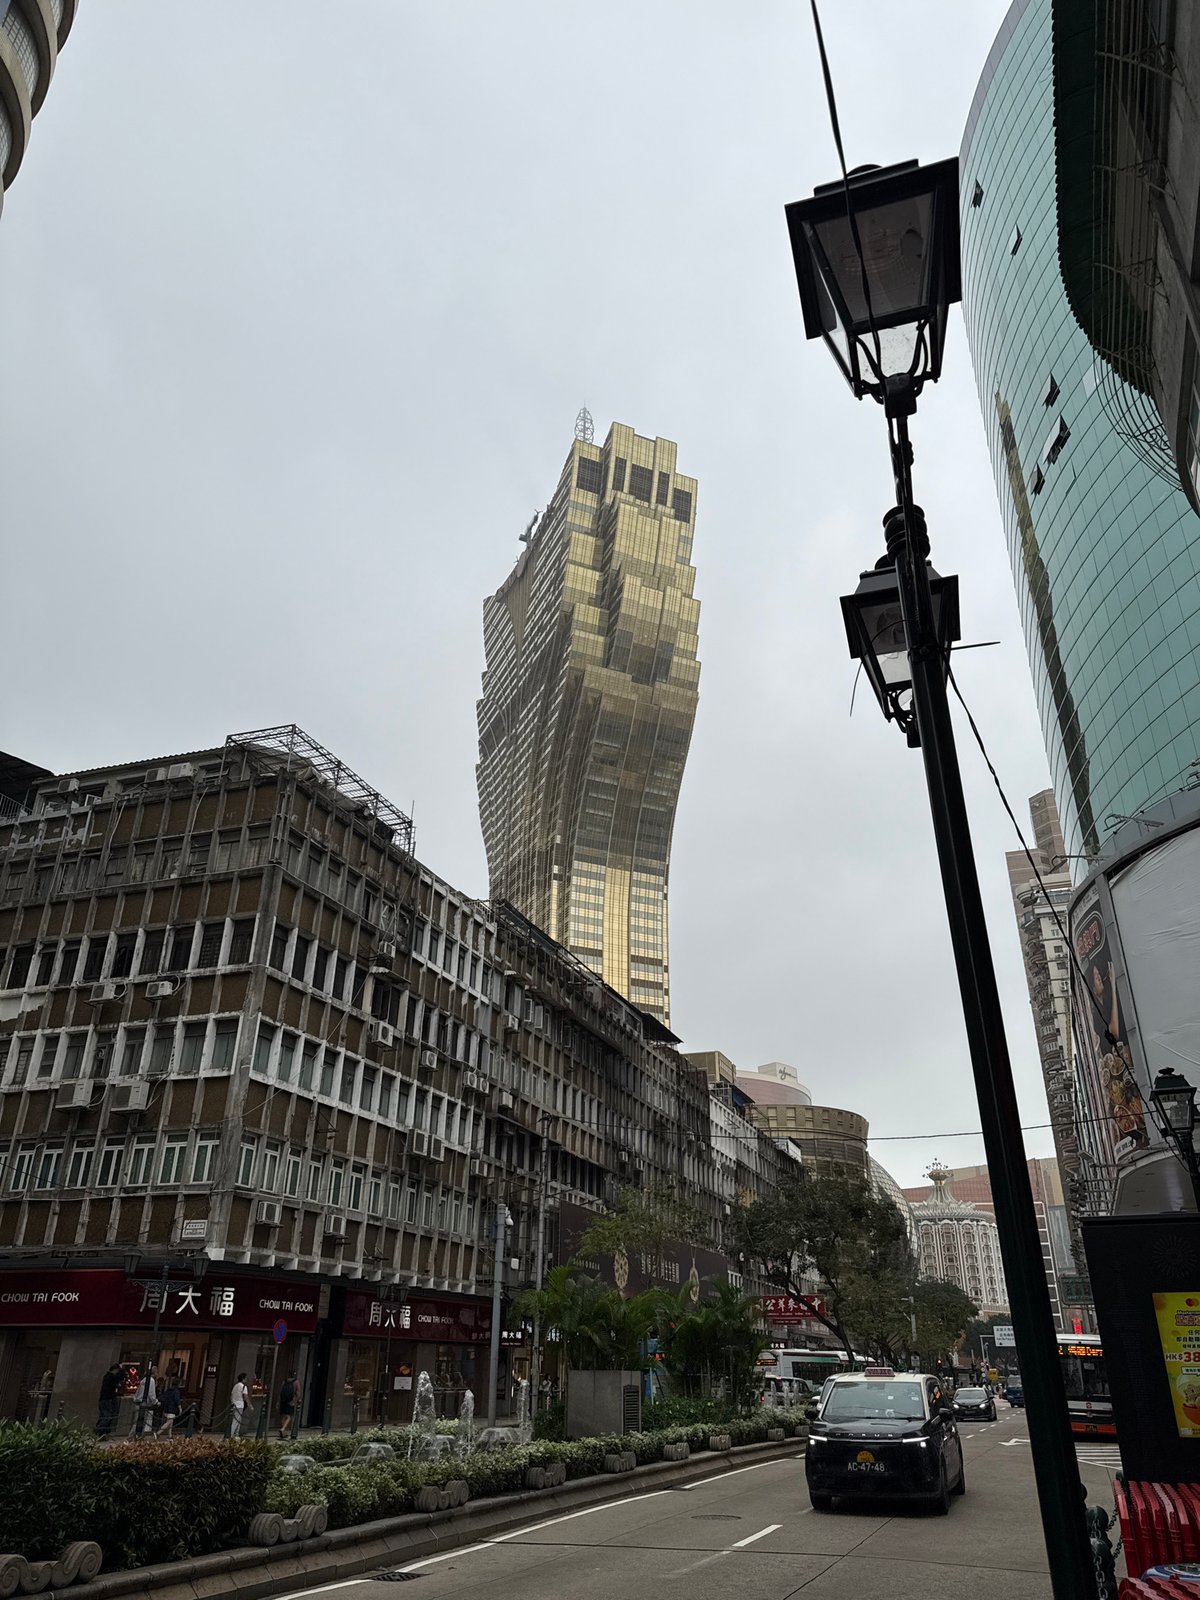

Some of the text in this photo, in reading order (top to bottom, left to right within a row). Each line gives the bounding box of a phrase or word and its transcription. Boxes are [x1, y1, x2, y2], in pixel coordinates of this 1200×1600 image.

[1, 1292, 80, 1302] CHOW TAI FOOK
[139, 1286, 236, 1317] 周大福
[259, 1299, 314, 1312] CHOW TAI FOOK
[418, 1314, 432, 1323] CHOW
